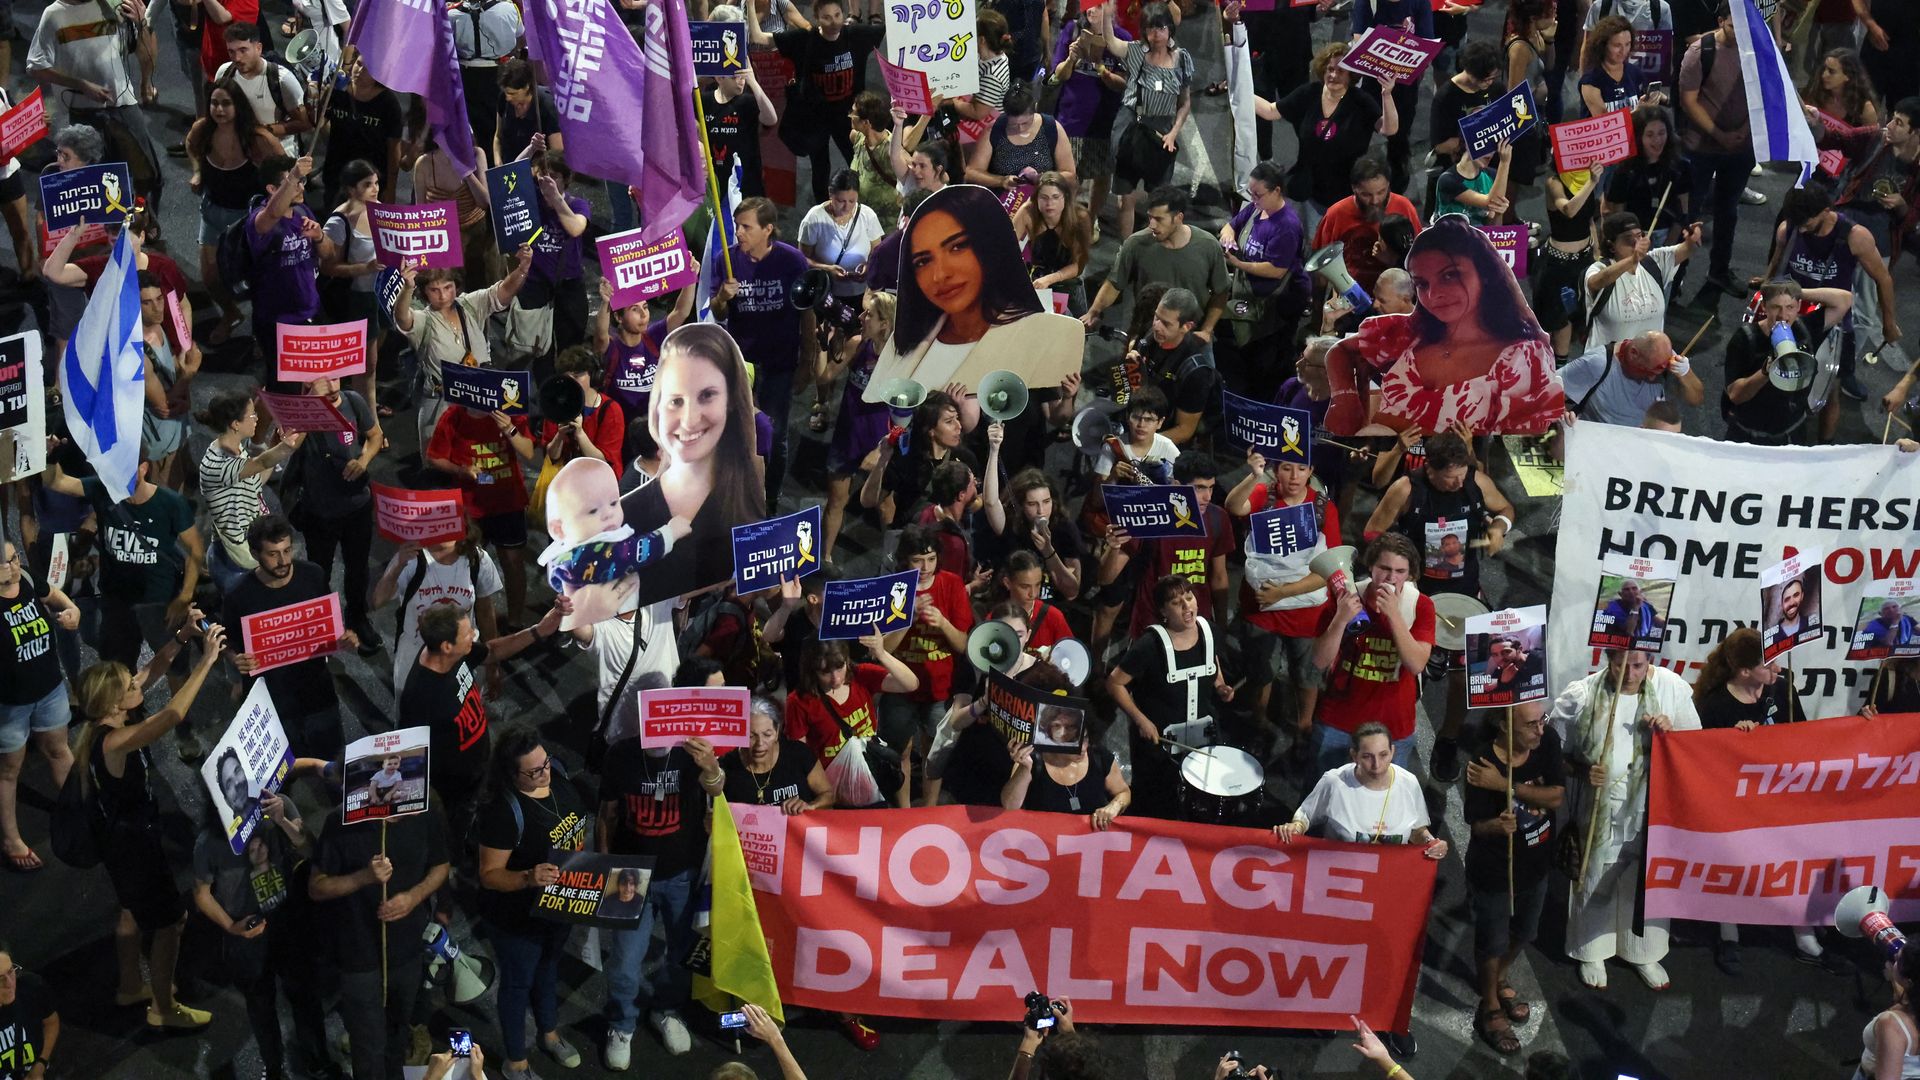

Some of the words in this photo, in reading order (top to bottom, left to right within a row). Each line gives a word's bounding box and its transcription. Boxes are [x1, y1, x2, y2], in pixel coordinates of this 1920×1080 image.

[693, 40, 719, 49] הבית
[1501, 114, 1514, 124] עד
[1603, 117, 1618, 129] רק
[1476, 121, 1500, 138] שהם
[1564, 122, 1599, 138] עסקה!
[1474, 123, 1516, 151] חוזרים
[1606, 132, 1621, 144] רק
[1567, 137, 1602, 152] עסקה!
[1609, 147, 1624, 158] רק
[58, 184, 99, 204] הביתה
[52, 198, 101, 217] עכשיו!
[419, 208, 445, 219] לקבל
[373, 208, 402, 221] העסקה
[403, 210, 418, 221] את
[375, 220, 404, 230] המלחמה
[406, 220, 419, 230] את
[421, 217, 446, 229] לעצור
[380, 230, 443, 252] עכשיו
[1492, 230, 1517, 239] לקבל
[608, 239, 641, 255] העסקה
[646, 245, 658, 254] את
[660, 236, 678, 252] לעצור
[609, 250, 645, 265] המלחמה
[618, 253, 678, 286] עכשיו
[288, 338, 341, 350] שהפקיר
[344, 335, 357, 345] מי
[285, 357, 334, 369] להחזיר
[335, 351, 359, 363] חייב
[1111, 366, 1123, 386] FOR
[454, 380, 479, 393] שהם
[482, 387, 497, 397] עד
[449, 387, 498, 408] חוזרים
[1116, 388, 1127, 405] YO
[1238, 415, 1277, 434] הביתה
[1231, 423, 1278, 447] עכשיו!
[1605, 476, 1764, 525] BRING
[380, 502, 433, 516] שהפקיר
[436, 505, 450, 514] מי
[1123, 503, 1167, 513] הביתה
[430, 521, 456, 530] חייב
[1116, 514, 1171, 527] עכשיו!
[749, 548, 777, 563] שהם
[779, 543, 794, 555] עד
[1598, 527, 1763, 579] HOME
[1783, 545, 1920, 585] OW
[743, 556, 795, 581] חוזרים
[843, 595, 887, 610] הביתה
[307, 604, 324, 615] רק
[259, 610, 302, 630] עסקה!
[830, 608, 885, 626] עכשיו!
[1594, 614, 1616, 625] BRING
[11, 617, 50, 645] עדיין
[310, 622, 327, 633] רק
[1592, 622, 1607, 632] HIM
[262, 628, 305, 647] עסקה!
[1854, 632, 1875, 642] BRING
[312, 640, 328, 651] רק
[1851, 640, 1866, 650] HIM
[263, 645, 307, 664] עסקה!
[1469, 674, 1492, 685] BRING
[1470, 685, 1484, 693] HIM
[655, 703, 718, 714] שהפקיר
[720, 704, 737, 713] מי
[991, 683, 1036, 724] KARINA
[237, 727, 245, 743] HE
[244, 713, 256, 730] HAS
[252, 702, 262, 720] NO
[990, 702, 999, 713] WE
[1000, 708, 1010, 722] ARE
[1011, 716, 1031, 732] HERE
[243, 734, 255, 757] TIME
[253, 724, 263, 740] TO
[258, 708, 273, 732] WAIT.
[650, 721, 707, 733] להחזיר
[709, 721, 740, 732] חייב
[248, 745, 261, 771] BRING
[260, 732, 272, 750] HIM
[254, 753, 269, 784] HOME
[267, 736, 282, 763] ALIVE!
[346, 791, 369, 804] BRING
[346, 803, 360, 812] HIM
[240, 815, 257, 843] BRING
[549, 811, 578, 843] SISTERS
[746, 832, 774, 841] עצרו
[742, 840, 777, 852] המלח
[745, 853, 775, 865] הציל
[800, 823, 1380, 921] HOSTAGE
[1647, 855, 1876, 899] החטופים
[557, 871, 604, 889] ANIELA
[544, 884, 557, 894] WE
[559, 886, 577, 897] ARE
[578, 889, 600, 900] HERE
[539, 895, 563, 910] FOR
[567, 899, 597, 916] YOU!
[793, 926, 1113, 1001] DEAL
[1142, 942, 1349, 999] NOW
